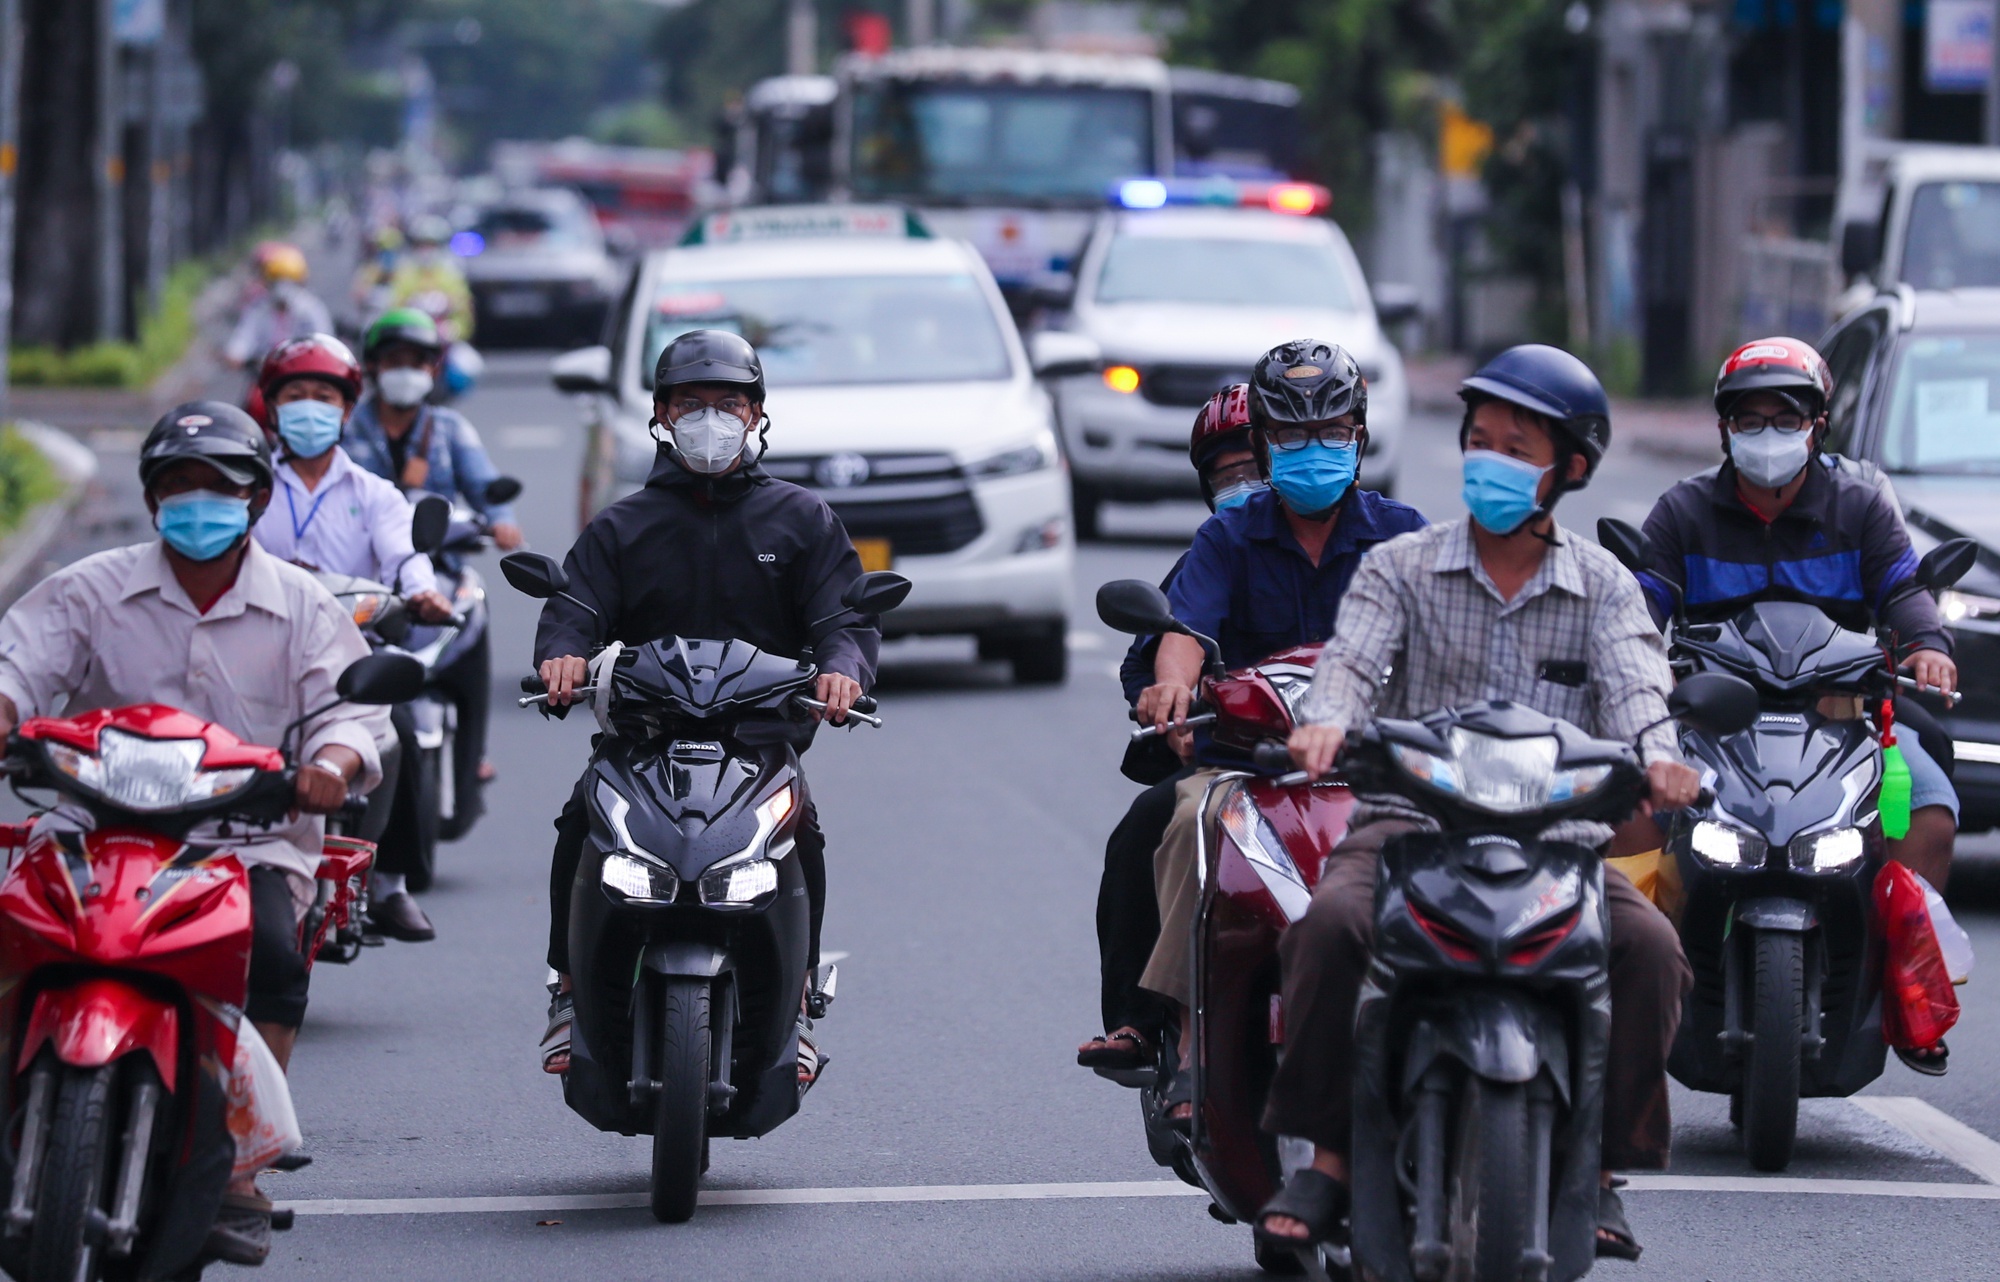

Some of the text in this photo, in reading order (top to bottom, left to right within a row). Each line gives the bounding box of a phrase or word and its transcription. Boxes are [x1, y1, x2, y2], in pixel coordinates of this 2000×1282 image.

[1760, 715, 1802, 725] HONDA
[675, 743, 718, 751] HONDA
[1467, 834, 1522, 849] HONDA
